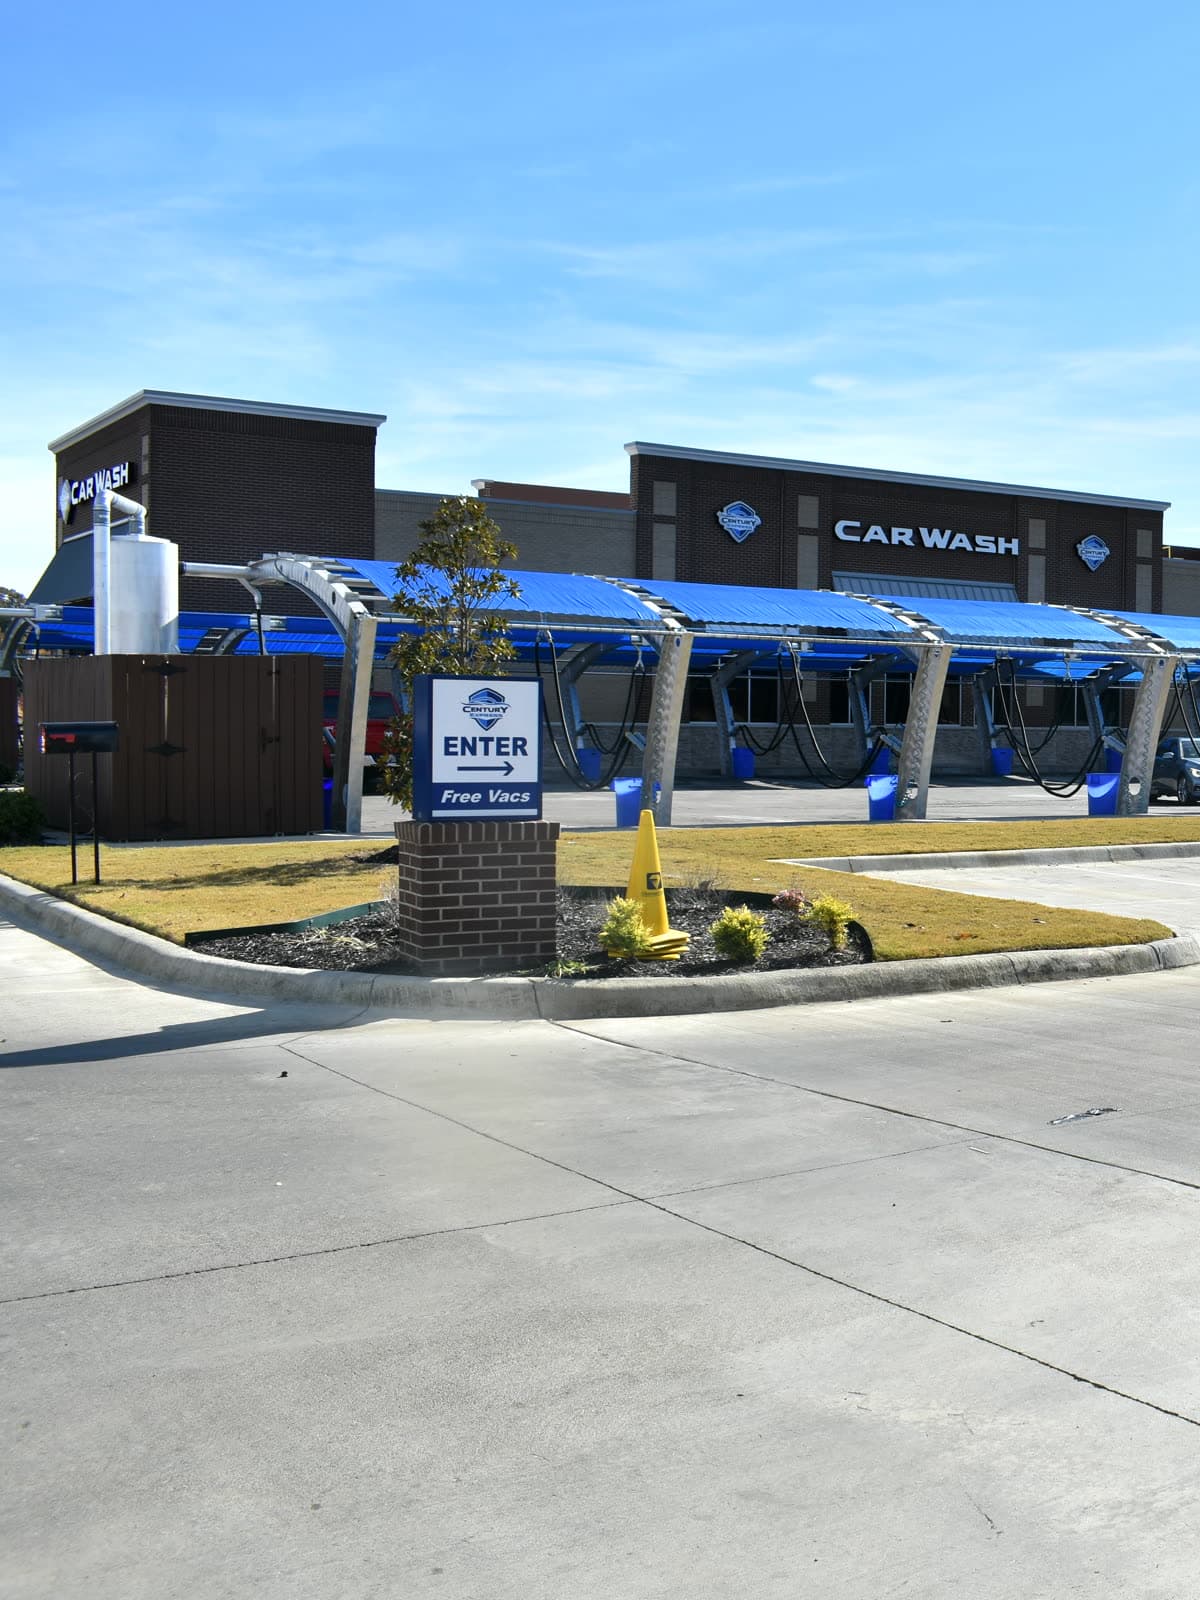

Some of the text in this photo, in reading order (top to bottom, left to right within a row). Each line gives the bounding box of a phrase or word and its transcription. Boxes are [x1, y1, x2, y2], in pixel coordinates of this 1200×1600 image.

[71, 462, 129, 505] CAR WASH
[834, 520, 1019, 556] CAR WASH
[443, 736, 528, 757] ENTER
[440, 789, 530, 804] Free Vacs
